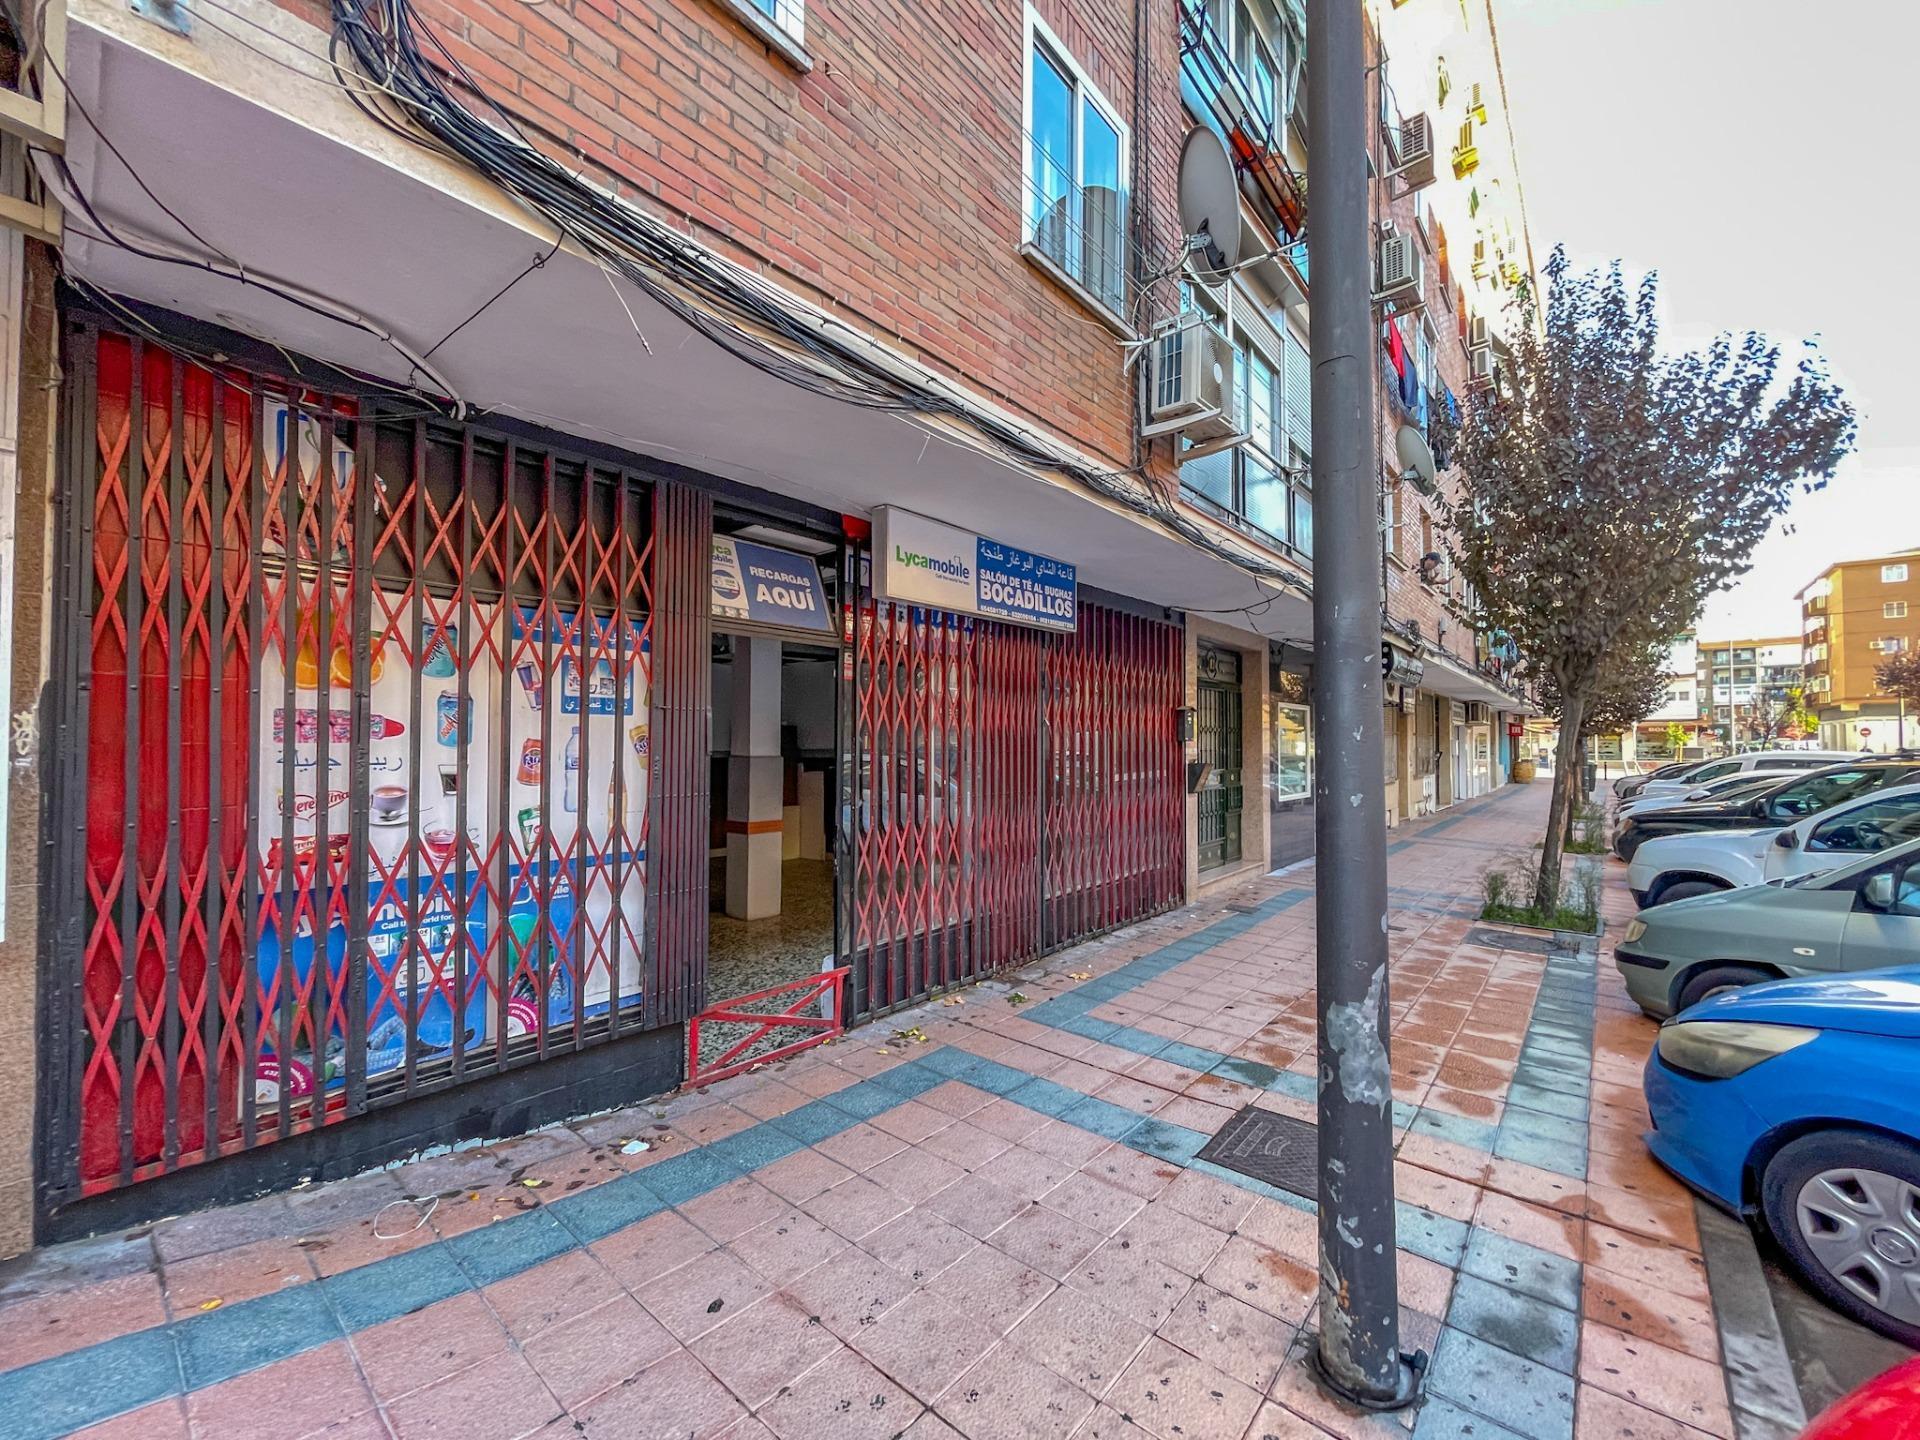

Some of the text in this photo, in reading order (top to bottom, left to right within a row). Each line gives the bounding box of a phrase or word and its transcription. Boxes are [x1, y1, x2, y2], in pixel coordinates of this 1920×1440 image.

[749, 565, 811, 587] RECARGAS
[896, 545, 970, 579] Lycamobile
[756, 583, 816, 611] AQUÍ
[980, 568, 1007, 586] SALÓN
[1009, 576, 1020, 588] DE
[1022, 578, 1032, 591] TÉ
[1033, 583, 1043, 594] AL
[1044, 585, 1073, 601] BUGHAZ
[980, 579, 1073, 618] BOCADILLOS
